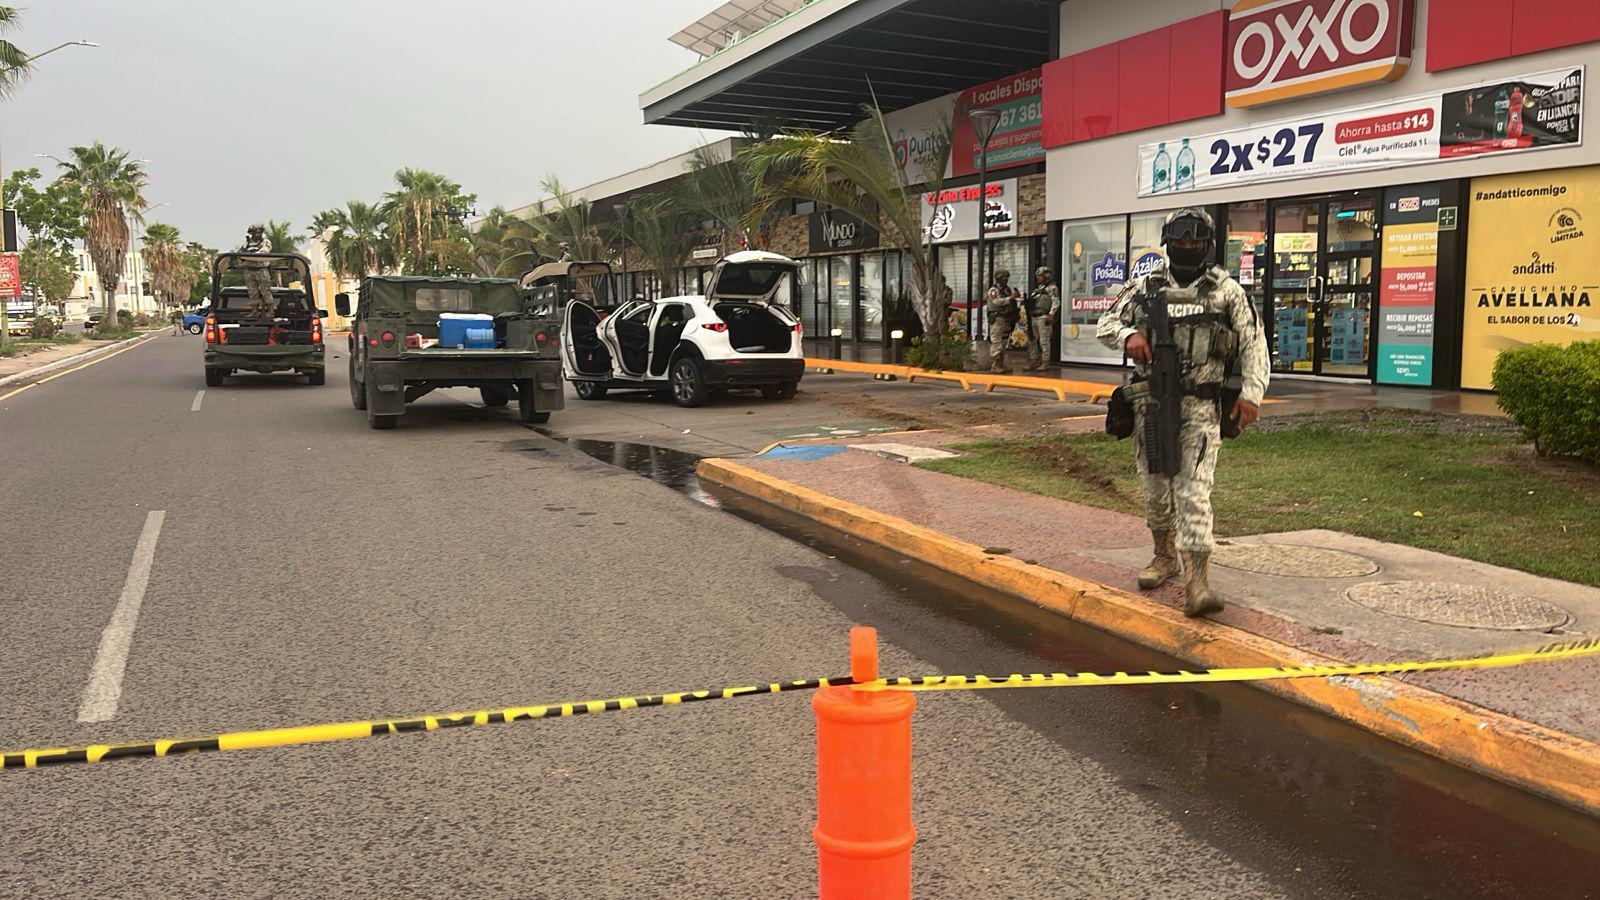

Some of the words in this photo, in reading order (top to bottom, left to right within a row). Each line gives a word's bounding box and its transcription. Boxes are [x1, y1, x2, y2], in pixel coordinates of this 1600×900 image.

[1233, 0, 1390, 84] OXXO
[997, 107, 1017, 129] 67
[1340, 127, 1371, 138] Ahorra
[1374, 122, 1402, 134] hasta
[1403, 113, 1429, 129] $14
[1210, 122, 1324, 176] 2x$27
[1362, 146, 1379, 154] Agua
[1381, 140, 1417, 152] Purificada
[927, 190, 957, 205] Ccina
[961, 183, 1002, 199] Expess
[1475, 185, 1567, 201] #andatticonmigo
[1551, 231, 1583, 243] LIMITADA
[1095, 265, 1123, 280] Posada
[1512, 261, 1555, 275] andatti
[1396, 272, 1426, 281] DEPOSITAR
[1491, 285, 1578, 293] CAPUCHINO
[1072, 297, 1082, 310] Lo
[1477, 292, 1591, 308] AVELLANA
[1167, 303, 1204, 317] RCITO
[1488, 315, 1498, 325] EL
[1500, 315, 1530, 325] SABOR
[1532, 315, 1545, 324] DE
[1547, 315, 1565, 324] LOS
